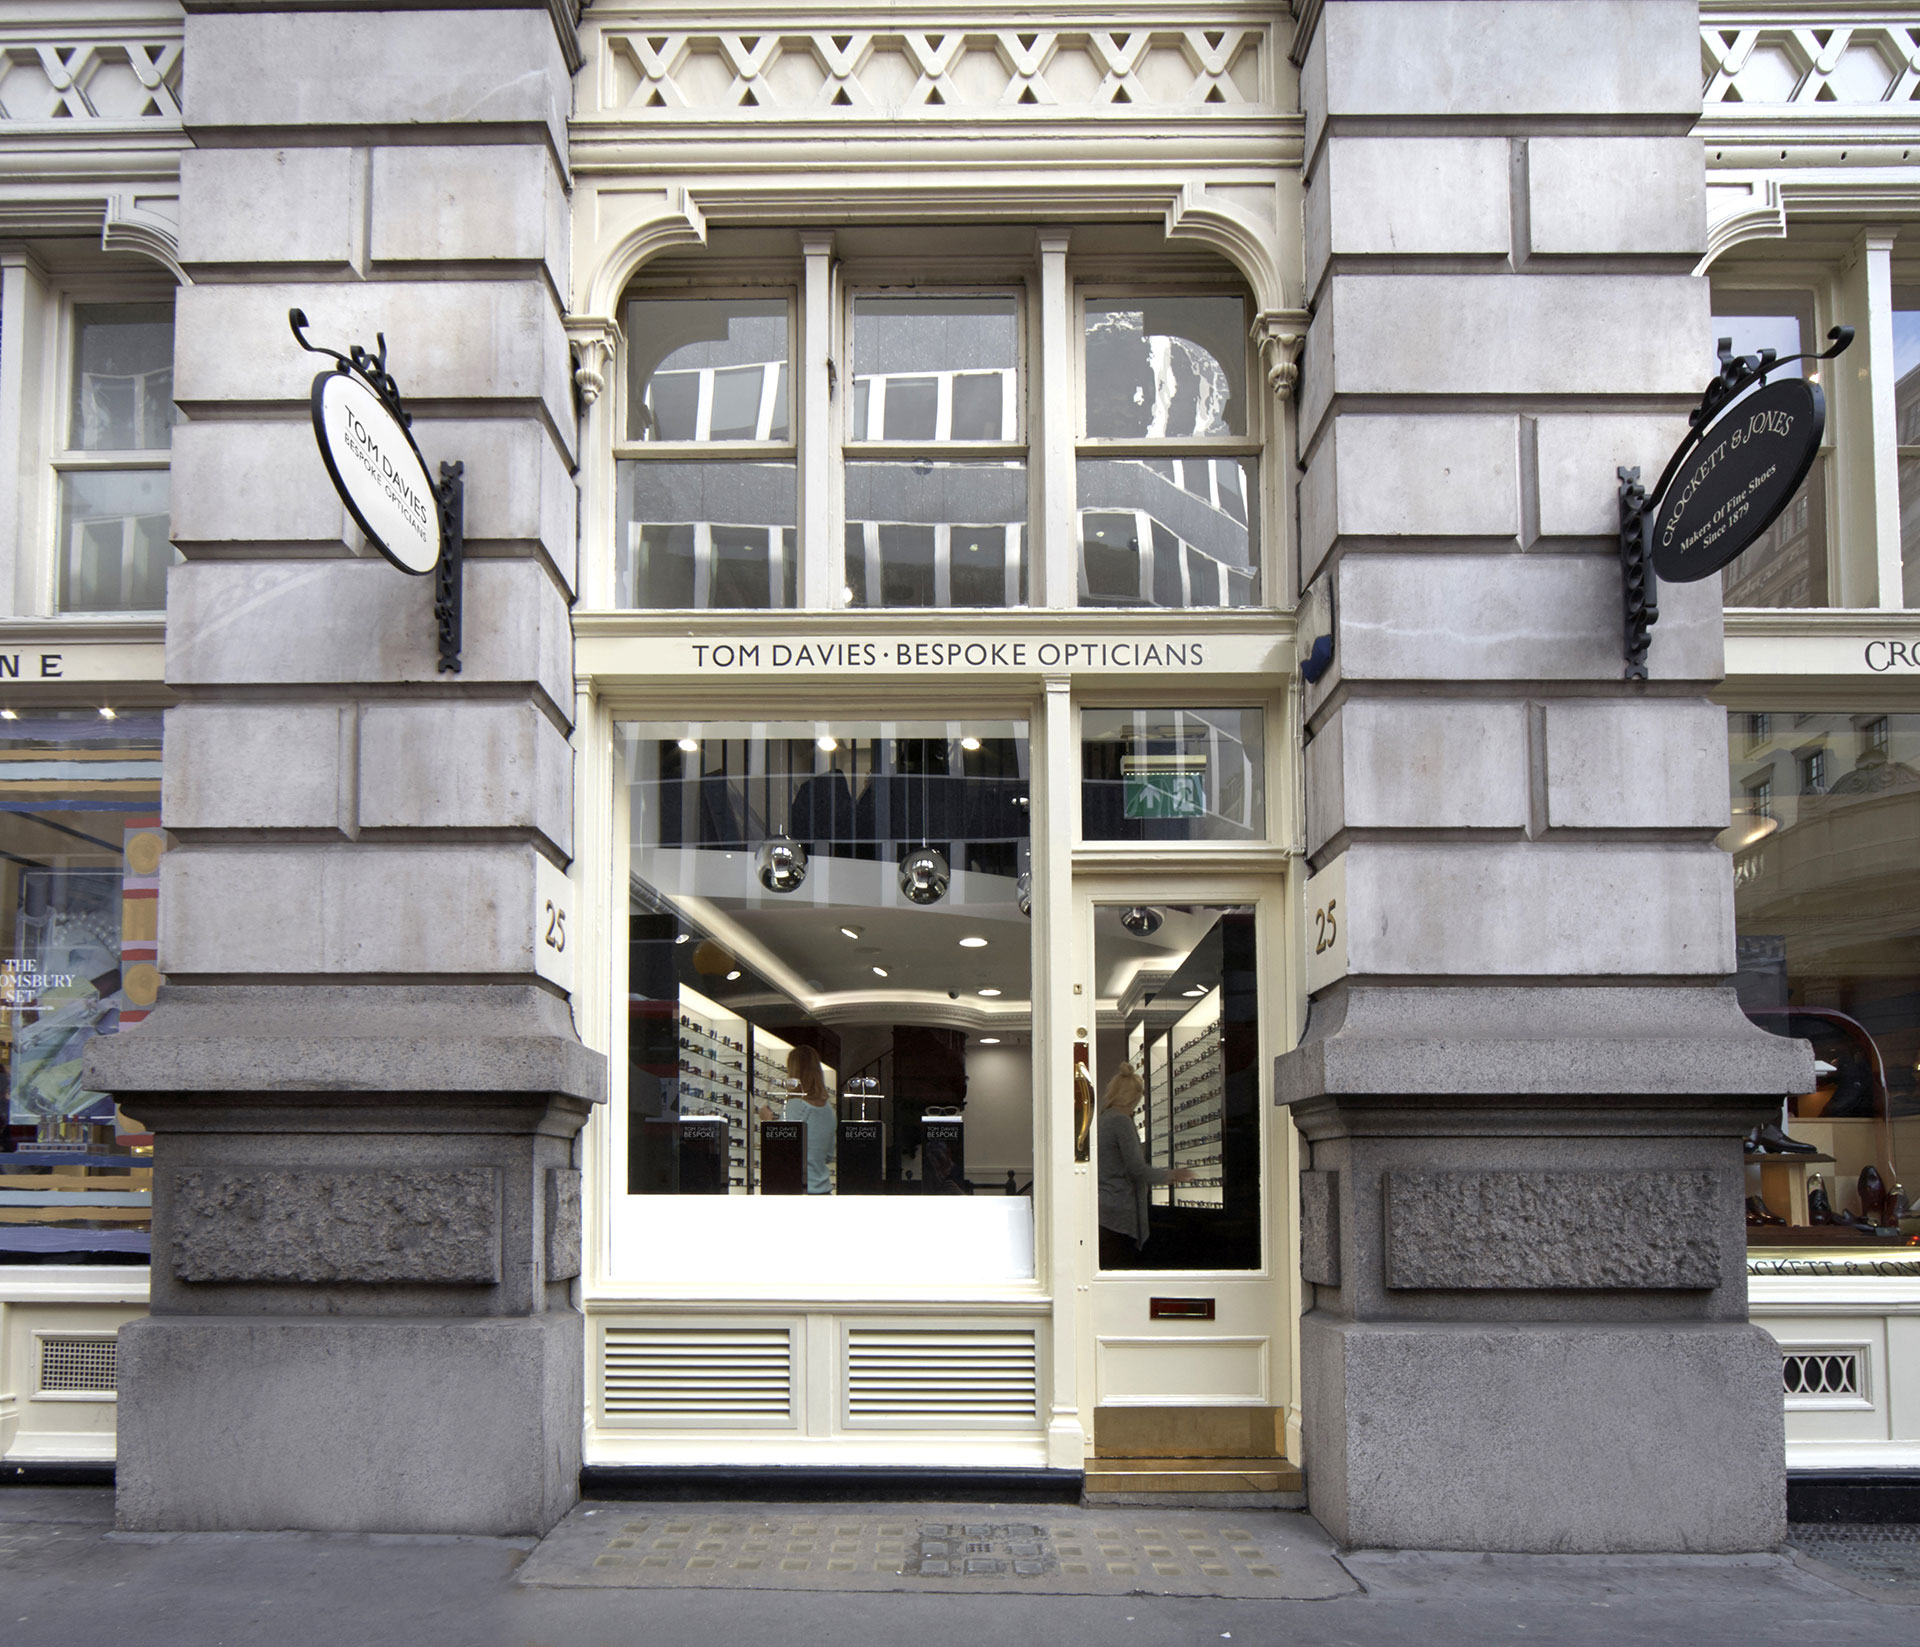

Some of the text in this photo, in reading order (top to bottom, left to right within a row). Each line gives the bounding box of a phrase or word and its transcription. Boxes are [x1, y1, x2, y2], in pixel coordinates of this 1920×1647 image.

[344, 433, 427, 543] BESPOKE OPTICIANS
[345, 405, 427, 524] TOM DAVIES
[1662, 410, 1795, 547] CROCKETT & JONES
[1679, 463, 1776, 554] Makers Of Fine Shoes
[1702, 501, 1750, 549] Since 1879
[692, 643, 1203, 667] TOM DAVIES BESPOKE OPTICIANS
[545, 899, 566, 953] 25
[1315, 898, 1337, 955] 25
[0, 974, 76, 988] OMSBURY
[5, 959, 37, 972] THE
[6, 989, 36, 1003] SET
